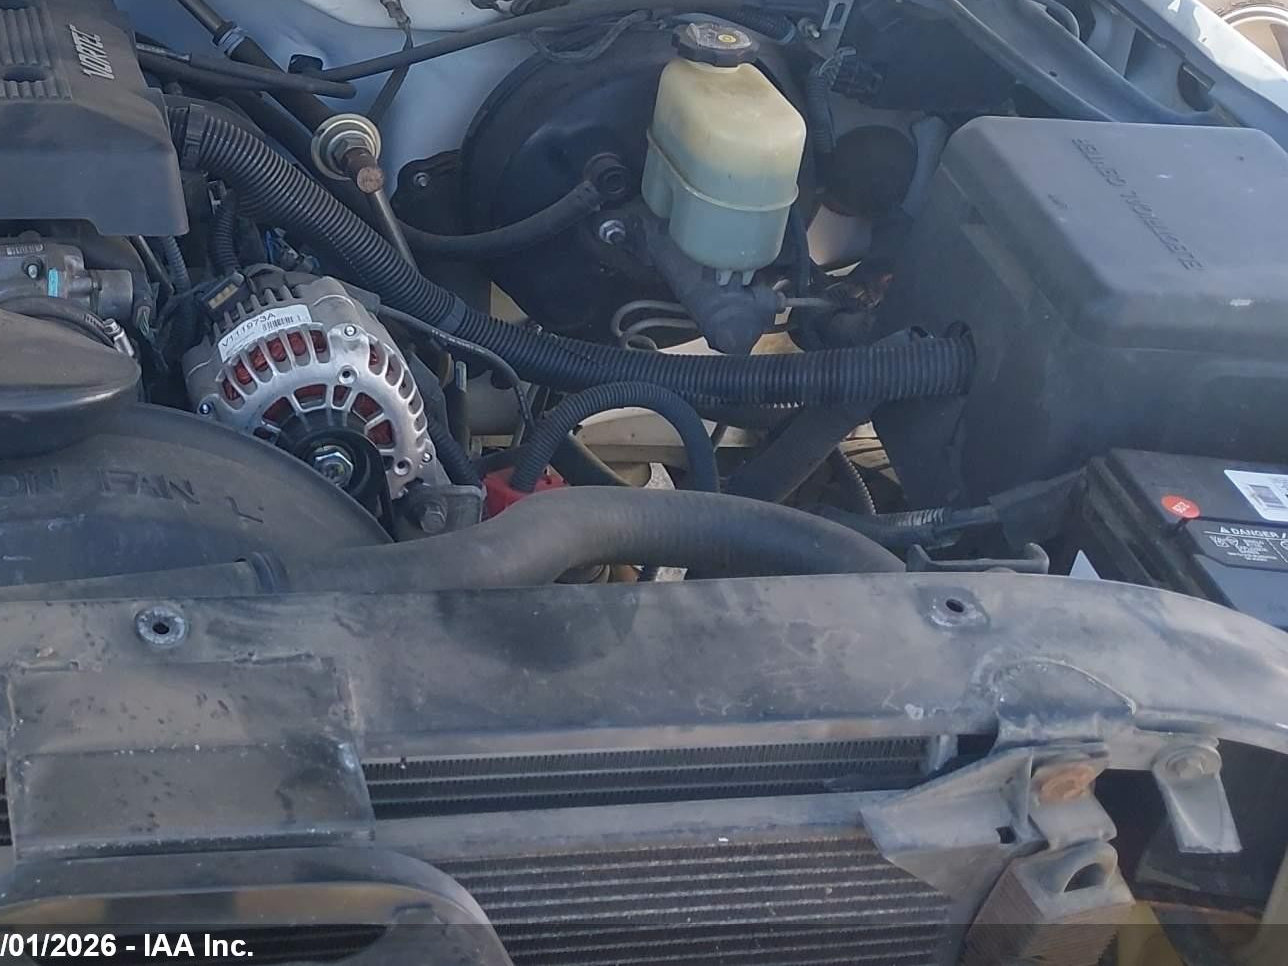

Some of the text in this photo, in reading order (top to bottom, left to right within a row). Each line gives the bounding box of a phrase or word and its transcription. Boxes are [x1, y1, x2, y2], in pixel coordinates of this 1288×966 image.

[69, 23, 115, 80] VORTEC
[98, 469, 201, 505] FAN
[1230, 527, 1280, 539] DANGER
